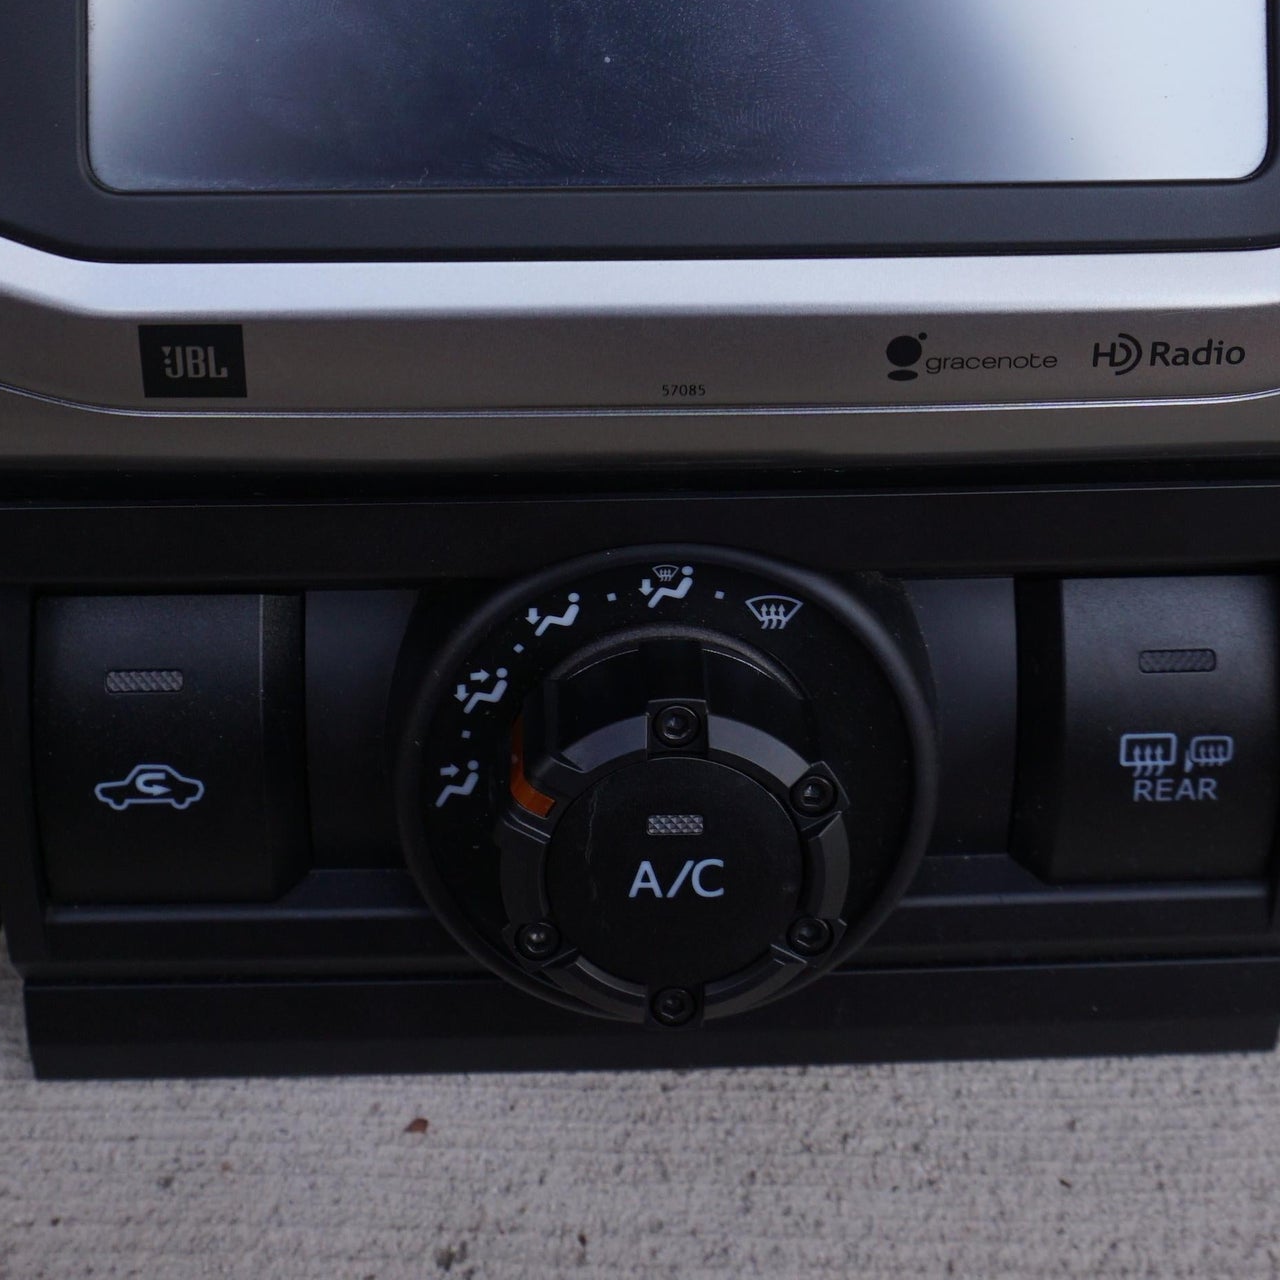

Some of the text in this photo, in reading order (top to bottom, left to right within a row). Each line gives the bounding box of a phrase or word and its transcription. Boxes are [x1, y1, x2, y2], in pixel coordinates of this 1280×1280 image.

[161, 345, 228, 378] JBL
[925, 352, 1058, 375] gracenote
[1149, 338, 1246, 367] Radio
[662, 384, 706, 396] 57085
[1133, 778, 1218, 802] REAR
[628, 858, 725, 899] A/C
